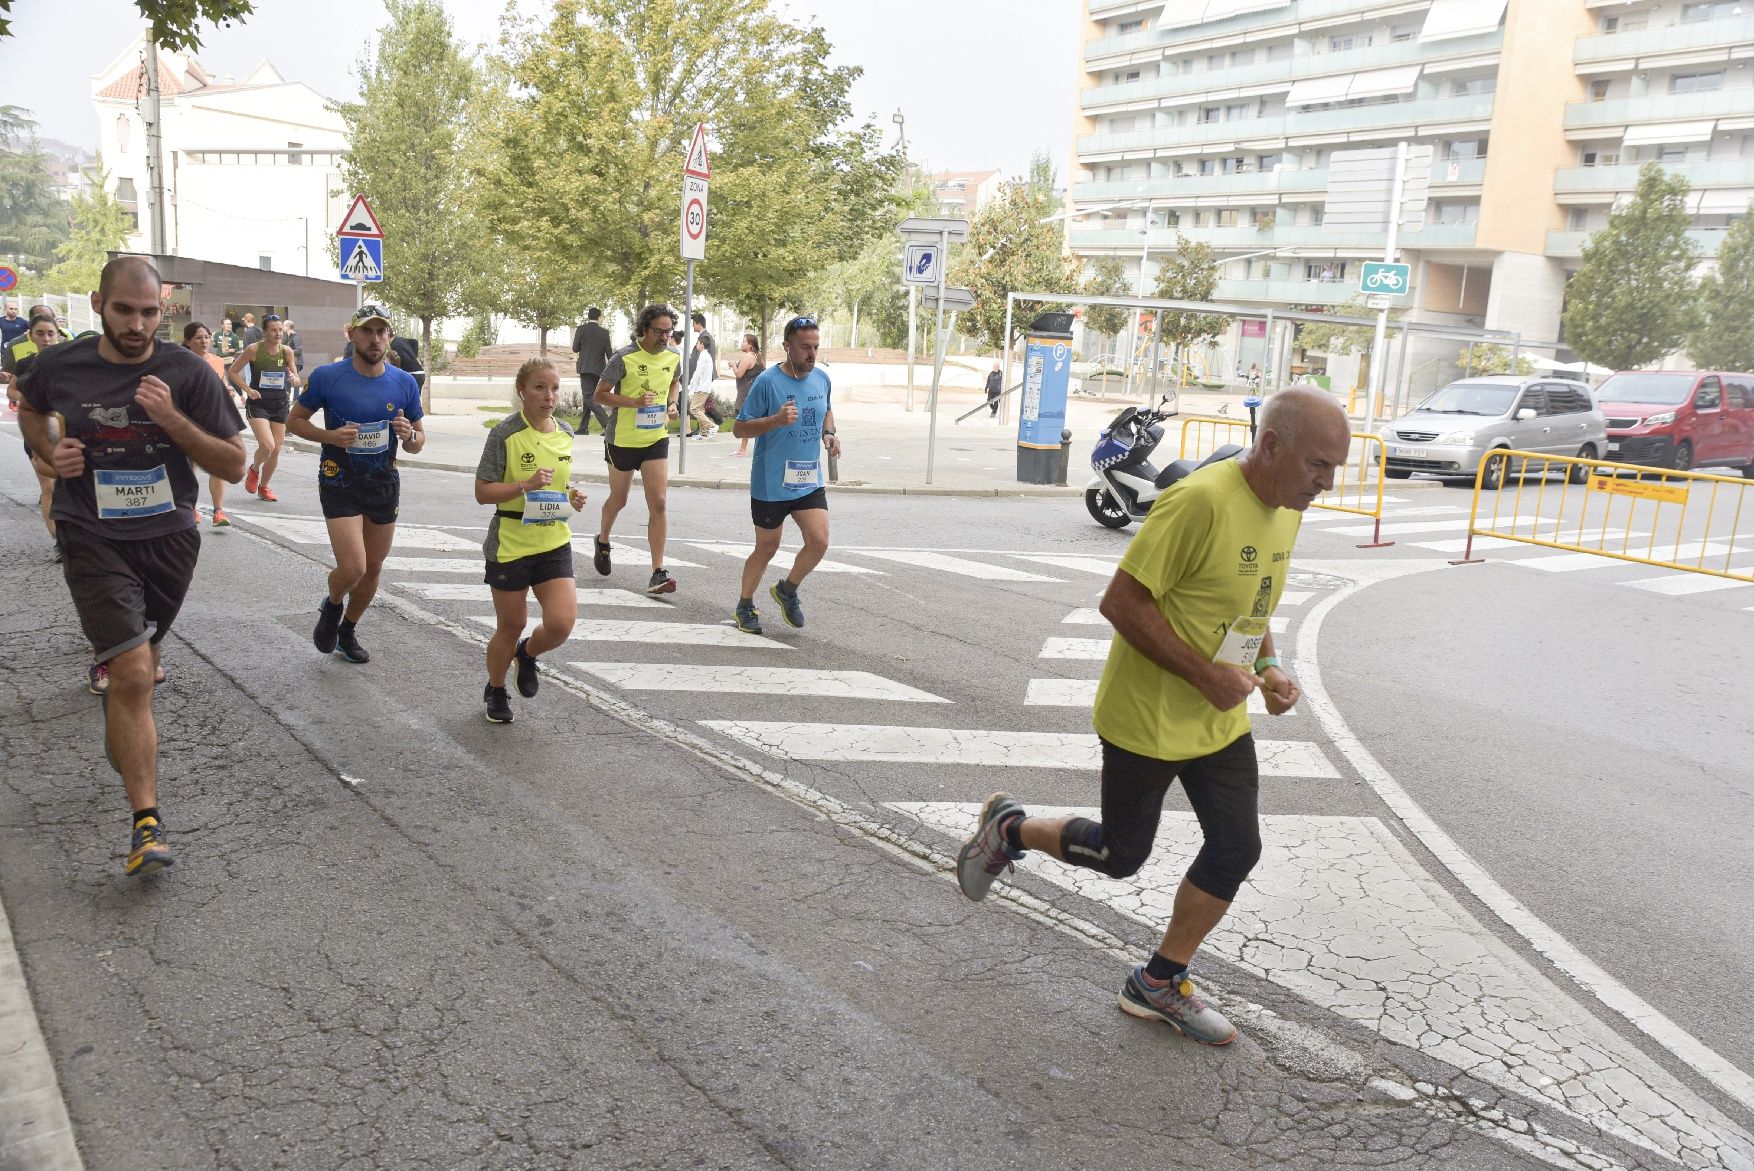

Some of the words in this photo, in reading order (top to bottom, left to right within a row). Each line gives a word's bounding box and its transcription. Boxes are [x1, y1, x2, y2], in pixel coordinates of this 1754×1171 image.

[689, 181, 704, 192] ZONA
[689, 211, 701, 226] 30
[115, 485, 155, 496] MARTI
[125, 497, 147, 507] 387
